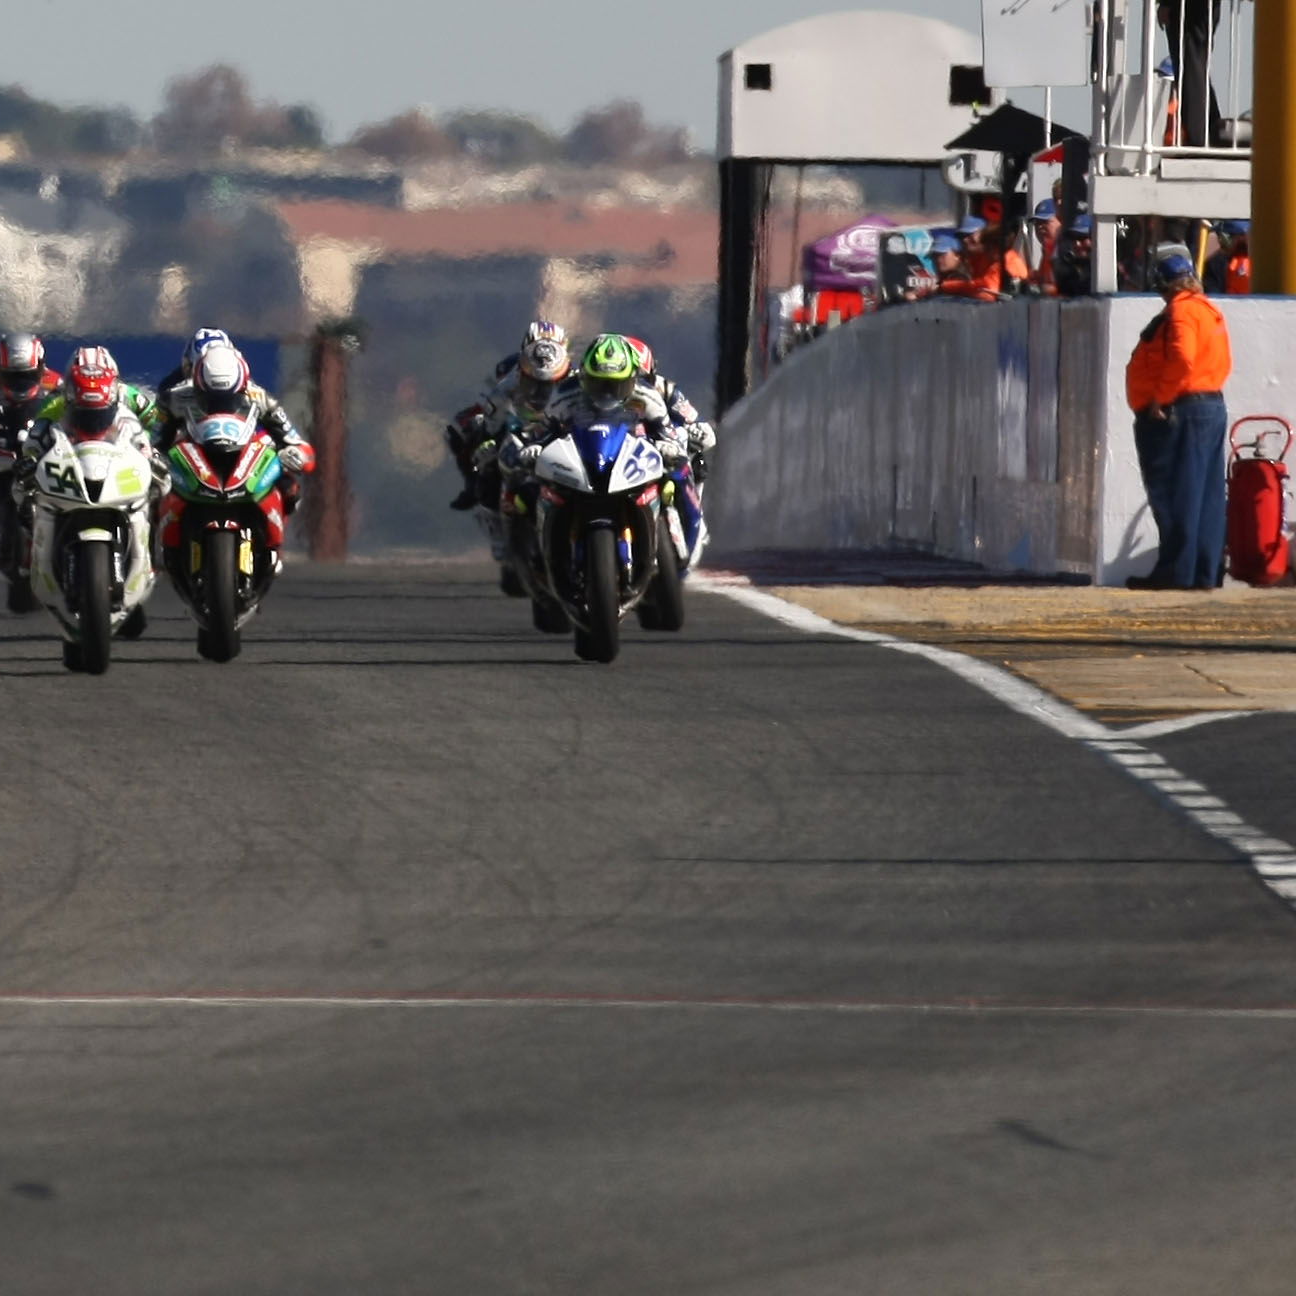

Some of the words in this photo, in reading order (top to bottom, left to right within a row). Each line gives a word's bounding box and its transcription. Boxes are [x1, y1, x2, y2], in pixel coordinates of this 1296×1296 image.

[203, 421, 241, 439] 26
[44, 461, 83, 499] 54
[623, 441, 661, 482] 35
